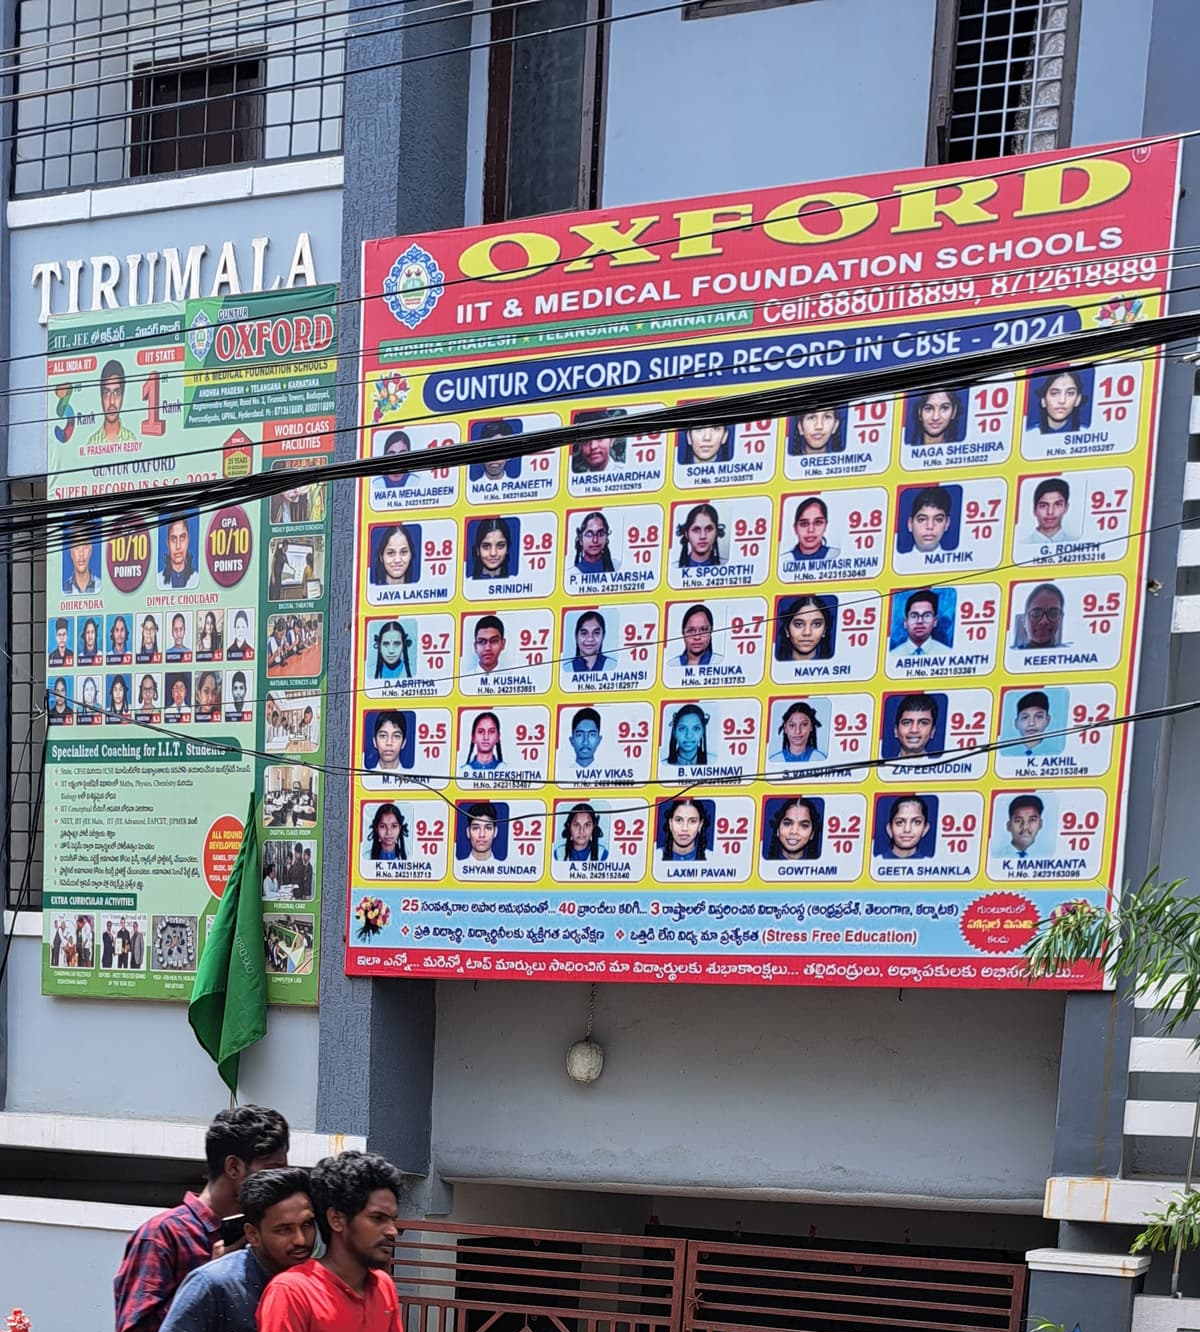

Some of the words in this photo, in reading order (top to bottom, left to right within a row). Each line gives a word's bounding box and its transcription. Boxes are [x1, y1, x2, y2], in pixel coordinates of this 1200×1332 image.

[458, 158, 1133, 282] OXFORD
[31, 232, 318, 324] TIRUMALA
[456, 302, 493, 324] IIT
[502, 298, 523, 319] &
[535, 281, 681, 314] MEDICAL
[692, 252, 923, 297] FOUNDATION
[936, 227, 1124, 270] SCHOOLS
[991, 257, 1157, 296] 8712618889
[219, 307, 248, 320] GUNTUR
[73, 333, 89, 346] JEE
[215, 314, 333, 361] OXFORD
[145, 352, 154, 362] IIT
[156, 350, 175, 361] STATE
[436, 374, 528, 403] GUNTUR
[537, 357, 641, 391] OXFORD
[649, 351, 723, 380] SUPER
[732, 340, 845, 375] RECORD
[856, 336, 882, 362] IN
[892, 331, 960, 359] CBSE
[992, 316, 1065, 350] 2024
[53, 363, 65, 373] ALL
[66, 362, 82, 371] INDIA
[200, 388, 220, 397] ANDHRA
[221, 386, 244, 395] PRADESH
[251, 382, 281, 392] TELANGANA
[288, 379, 319, 389] KARNATAKA
[1099, 375, 1134, 398] 10
[975, 388, 1008, 410] 10
[163, 399, 181, 414] Rank
[854, 401, 887, 421] 10
[77, 412, 96, 426] Rank
[1103, 407, 1126, 422] 10
[275, 425, 303, 436] WORLD
[305, 421, 329, 433] CLASS
[281, 438, 320, 450] FACILITIES
[1064, 432, 1108, 444] SINDHU
[123, 442, 142, 452] REDDY
[912, 448, 943, 459] NAGA
[947, 442, 1004, 455] SHESHIRA
[132, 457, 175, 473] OXFORD
[801, 453, 872, 467] GREESHMIKA
[687, 467, 716, 477] SOHA
[718, 463, 763, 474] MUSKAN
[572, 471, 660, 485] HARSHAVARDHAN
[375, 491, 396, 500] WAFA
[399, 486, 454, 498] MEHAJABEEN
[472, 483, 498, 493] NAGA
[502, 480, 552, 490] PRANEETH
[966, 500, 1001, 519] 9.7
[221, 518, 237, 528] GPA
[735, 519, 767, 536] 9.8
[210, 528, 249, 555] 10/10
[523, 533, 552, 549] 9.8
[110, 534, 148, 562] 10/10
[740, 544, 759, 556] 10
[1041, 545, 1052, 554] G.
[1056, 543, 1099, 554] ROHITH
[925, 552, 973, 564] NAITHIK
[214, 560, 243, 572] POINTS
[682, 568, 692, 578] K.
[697, 565, 753, 577] SPOORTHI
[783, 561, 806, 573] UZMA
[808, 559, 851, 570] MUNTASIR
[854, 557, 878, 567] KHAN
[114, 566, 142, 578] POINTS
[570, 576, 578, 585] P.
[581, 574, 608, 584] HIMA
[611, 572, 654, 582] VARSHA
[377, 591, 401, 601] JAYA
[403, 589, 447, 599] LAKSHMI
[489, 584, 532, 594] SRINIDHI
[61, 600, 103, 611] DHIRENDRA
[147, 597, 175, 606] DIMPLE
[178, 594, 219, 605] CHOUDARY
[961, 601, 995, 619] 9.5
[732, 616, 764, 634] 9.7
[422, 634, 450, 649] 9.7
[896, 656, 946, 668] ABHINAV
[949, 654, 988, 665] KANTH
[1024, 654, 1098, 666] KEERTHANA
[572, 673, 608, 682] AKHILA
[611, 672, 647, 681] JHANSI
[685, 667, 696, 676] M.
[699, 666, 742, 675] RENUKA
[795, 667, 830, 677] NAVYA
[833, 666, 851, 675] SRI
[385, 680, 393, 688] D.
[493, 676, 532, 685] KUSHAL
[951, 712, 985, 730] 9.2
[419, 724, 446, 739] 9.5
[52, 745, 99, 760] Specialized
[102, 744, 141, 757] Coaching
[143, 743, 155, 756] for
[158, 742, 183, 756] I.I.T.
[186, 741, 225, 755] Students
[424, 746, 440, 758] 10
[1027, 758, 1038, 767] K.
[1042, 757, 1077, 766] AKHIL
[576, 769, 601, 779] VIJAY
[603, 769, 633, 778] VIKAS
[678, 768, 688, 777] B.
[691, 766, 743, 776] VAISHNAVI
[892, 763, 971, 775] ZAFEERUDDIN
[942, 815, 976, 832] 9.0
[1063, 812, 1099, 830] 9.0
[416, 821, 444, 836] 9.2
[614, 820, 644, 836] 9.2
[212, 831, 222, 839] ALL
[387, 862, 431, 870] TANISHKA
[463, 866, 495, 874] SHYAM
[498, 866, 536, 874] SUNDAR
[569, 863, 578, 871] A.
[582, 863, 631, 872] SINDHUJA
[778, 866, 837, 875] GOWTHAMI
[878, 867, 915, 876] GEETA
[918, 866, 970, 876] SHANKLA
[1003, 860, 1013, 870] K.
[1017, 859, 1086, 869] MANIKANTA
[667, 869, 698, 878] LAXMI
[701, 869, 736, 878] PAVANI
[51, 896, 68, 905] EXTRA
[69, 896, 103, 906] CURRICULAR
[105, 897, 134, 906] ACTIVITIES
[402, 899, 419, 911] 25
[559, 903, 575, 914] 40
[651, 903, 659, 915] 3
[762, 929, 807, 944] (Stress
[812, 930, 841, 942] Free
[845, 929, 917, 945] Education)
